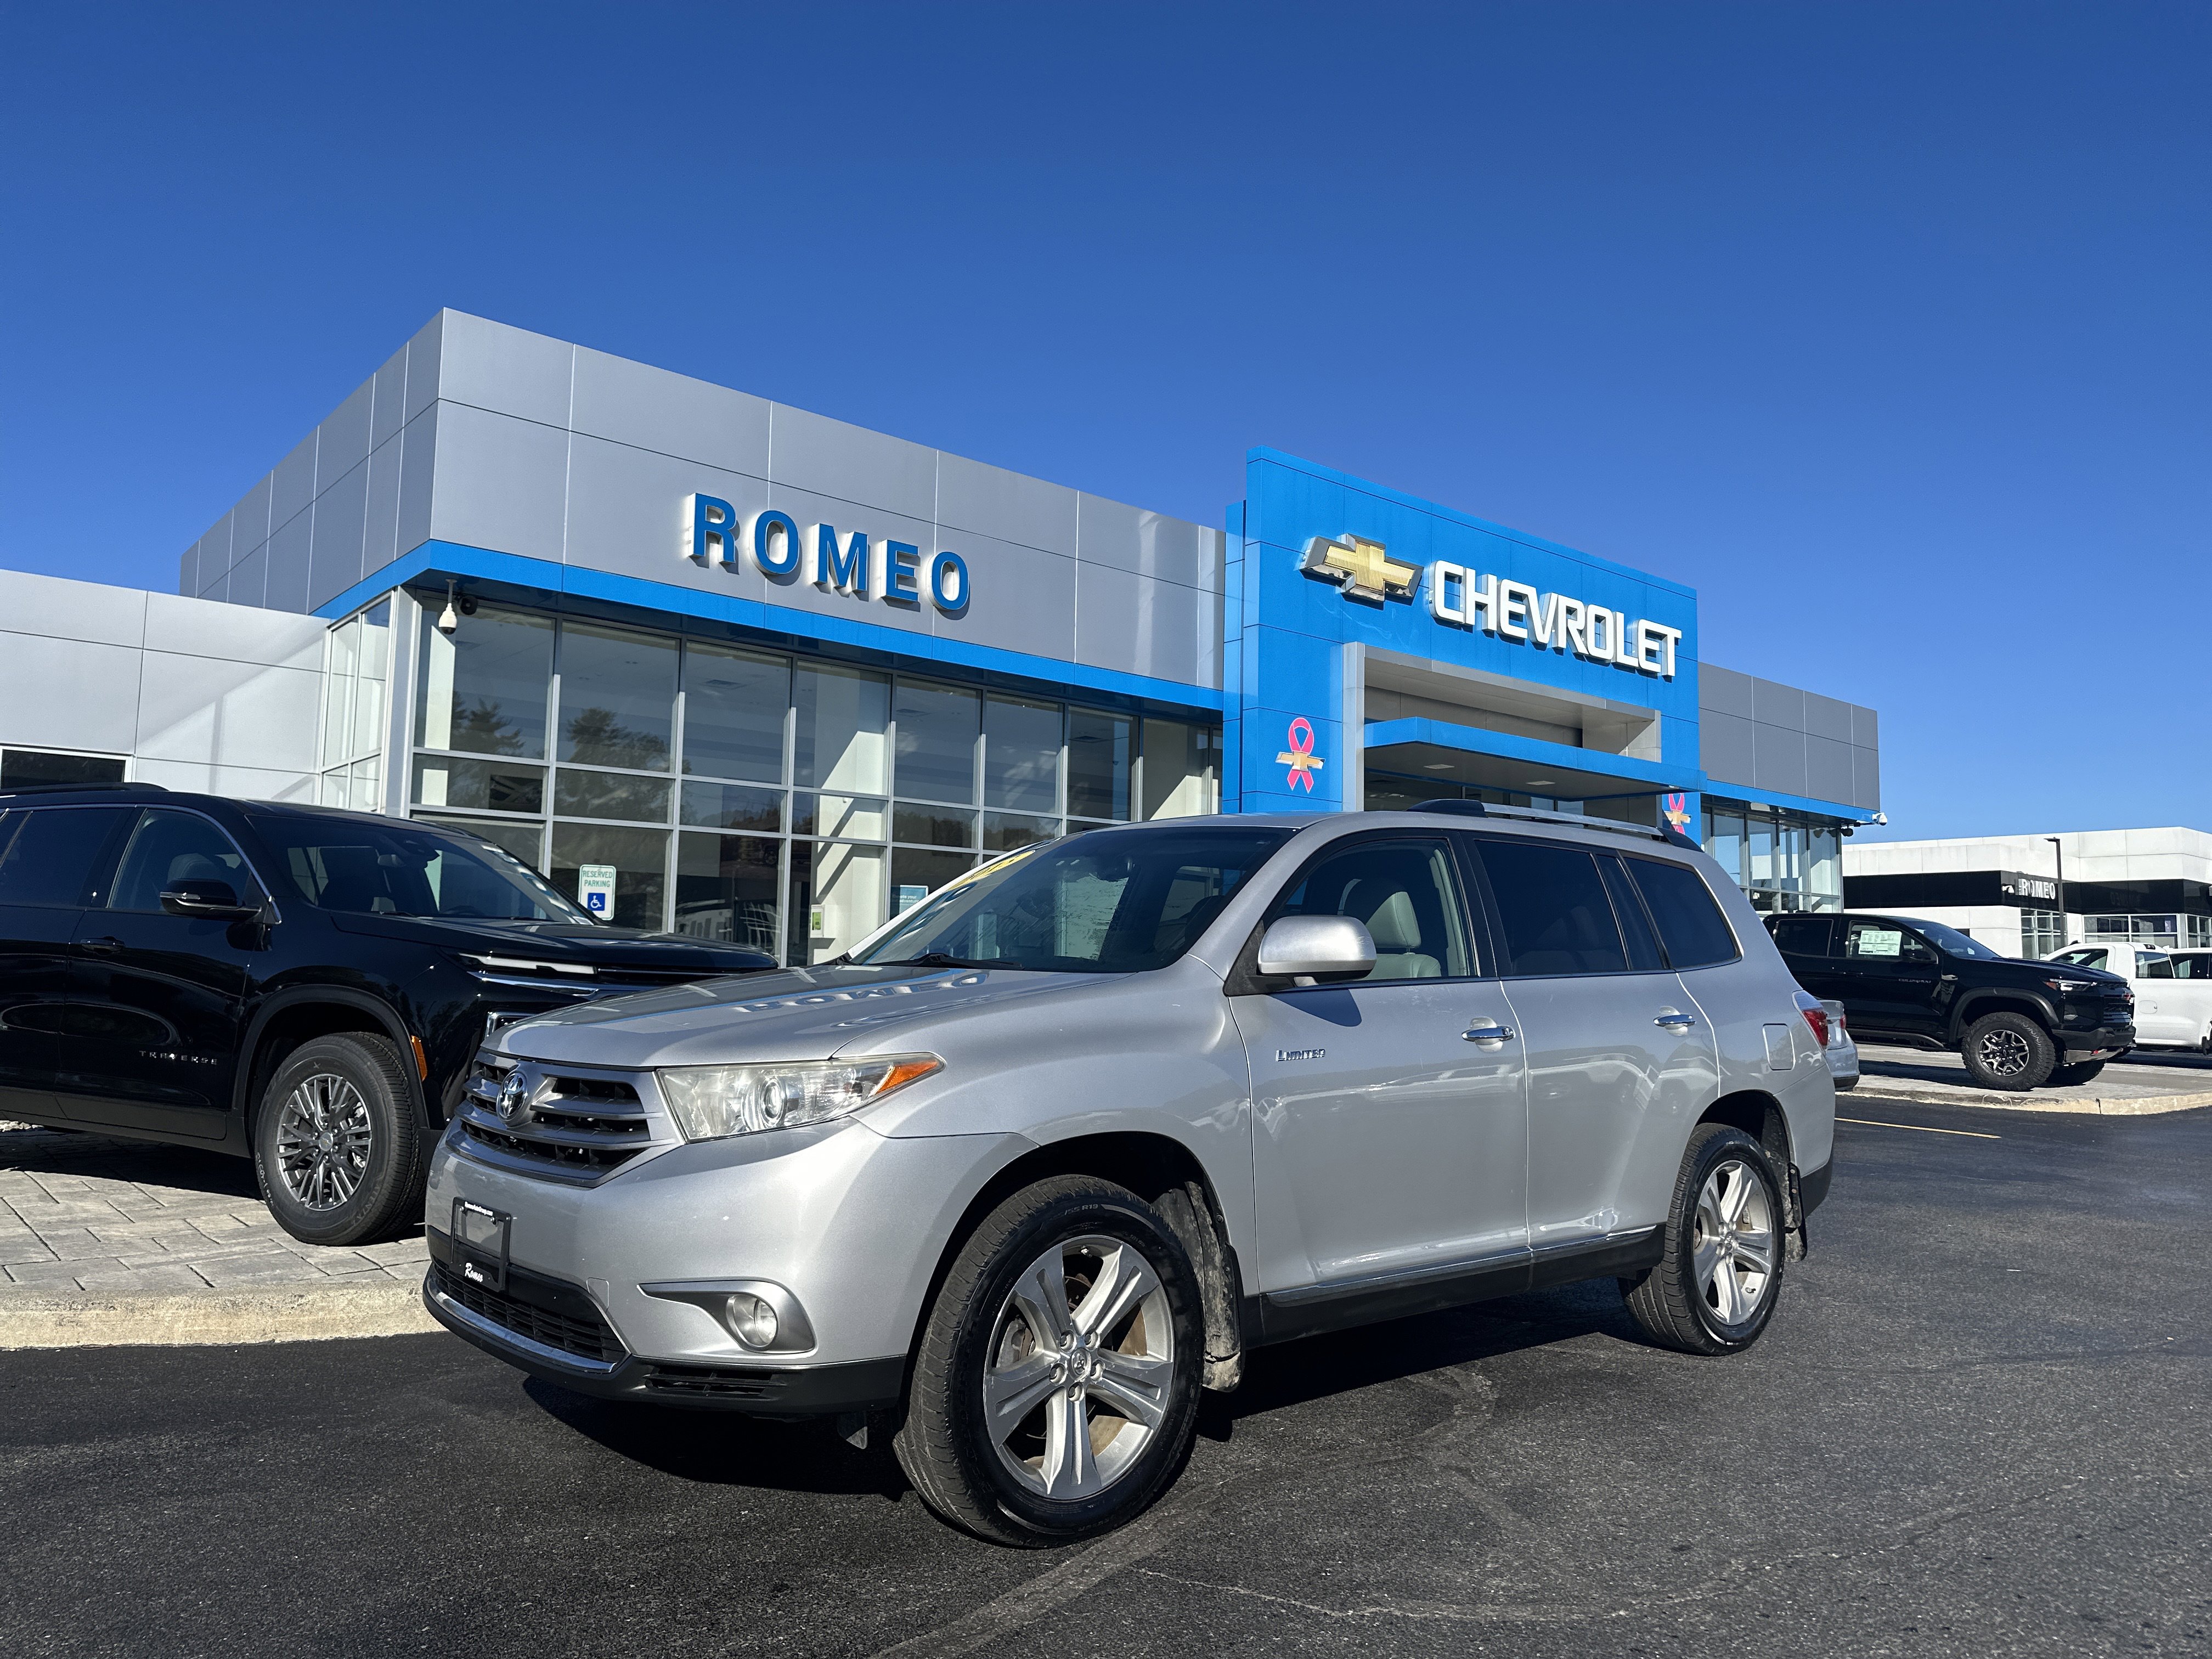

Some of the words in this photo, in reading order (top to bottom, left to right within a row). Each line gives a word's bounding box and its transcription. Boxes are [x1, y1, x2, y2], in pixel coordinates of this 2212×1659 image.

[688, 492, 970, 611] ROMEO
[1430, 560, 1683, 678] CHEVROLET
[582, 870, 613, 878] RESERVED
[2018, 878, 2056, 900] ROMEO
[1275, 1048, 1325, 1062] LIMITED
